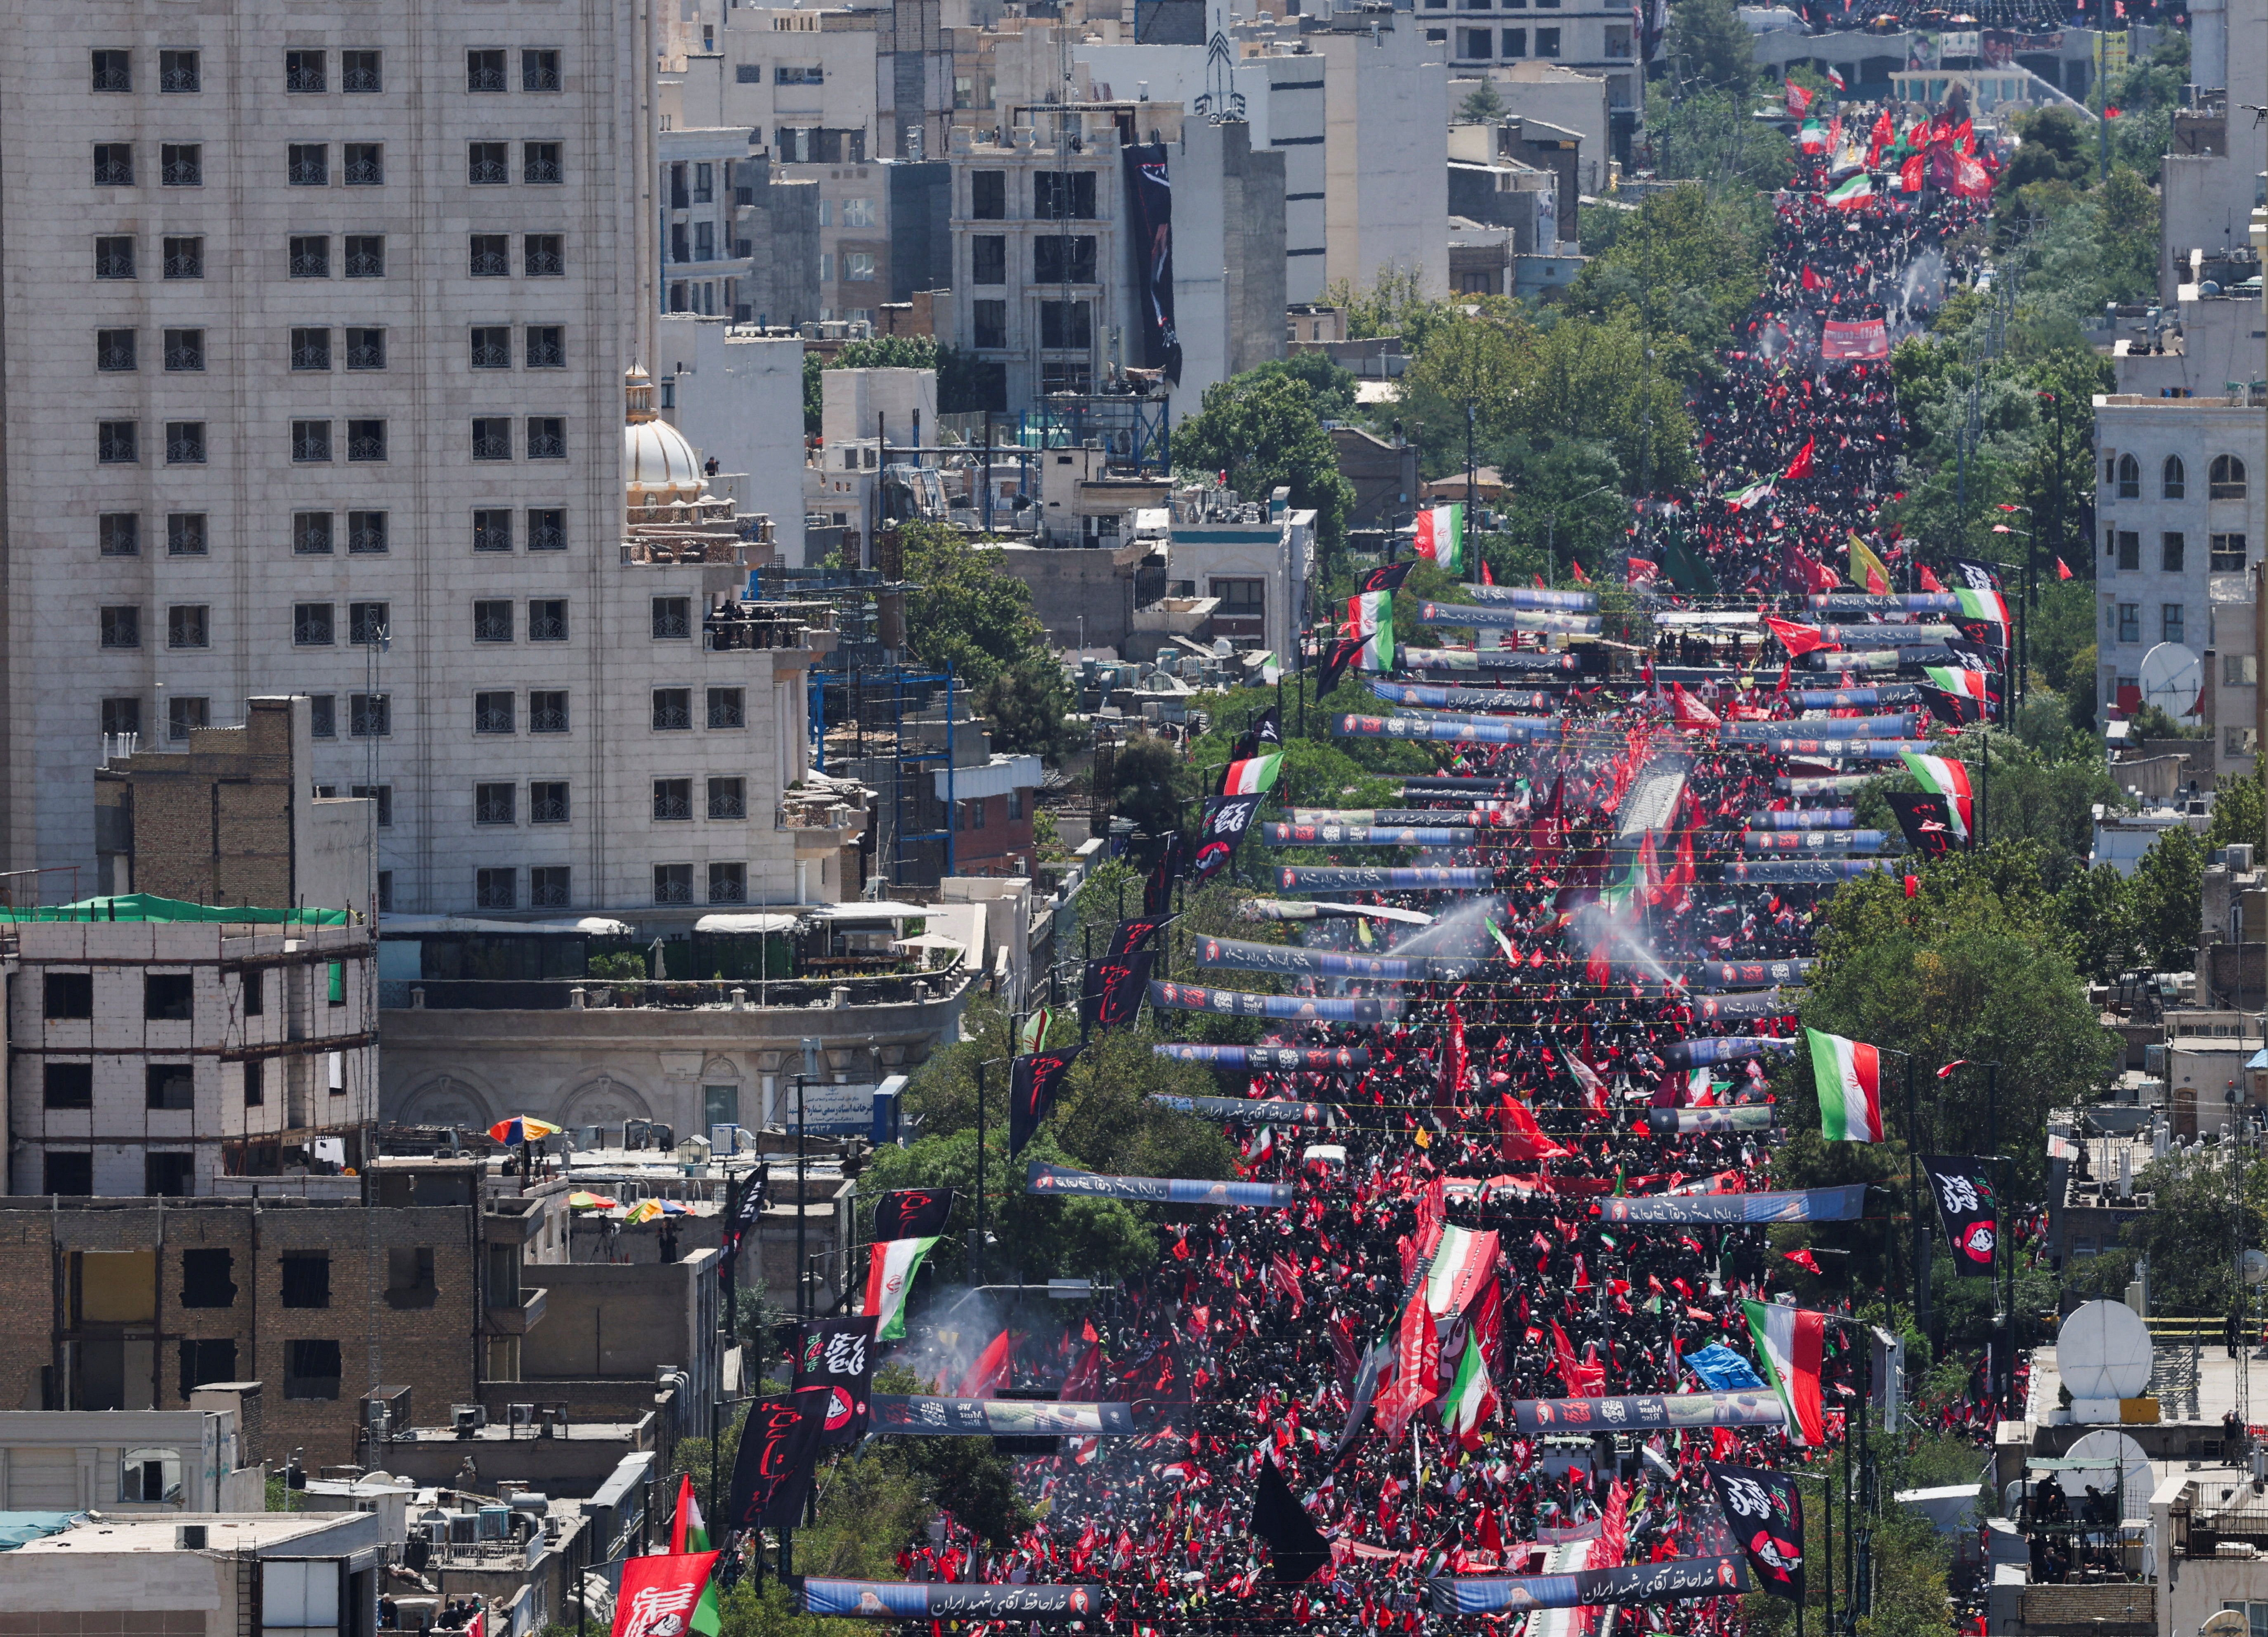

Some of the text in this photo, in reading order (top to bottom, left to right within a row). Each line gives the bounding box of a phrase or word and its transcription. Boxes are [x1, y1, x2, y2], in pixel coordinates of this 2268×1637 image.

[839, 1103, 852, 1113] اسناد
[1225, 1102, 1244, 1120] شهید
[1243, 1102, 1272, 1123] آقای
[1268, 1107, 1301, 1121] خداحافظ
[1581, 1566, 1715, 1605] خداحافظ آقای شهید ایران
[930, 1588, 1067, 1617] خداحافظ آقای شهید ایران
